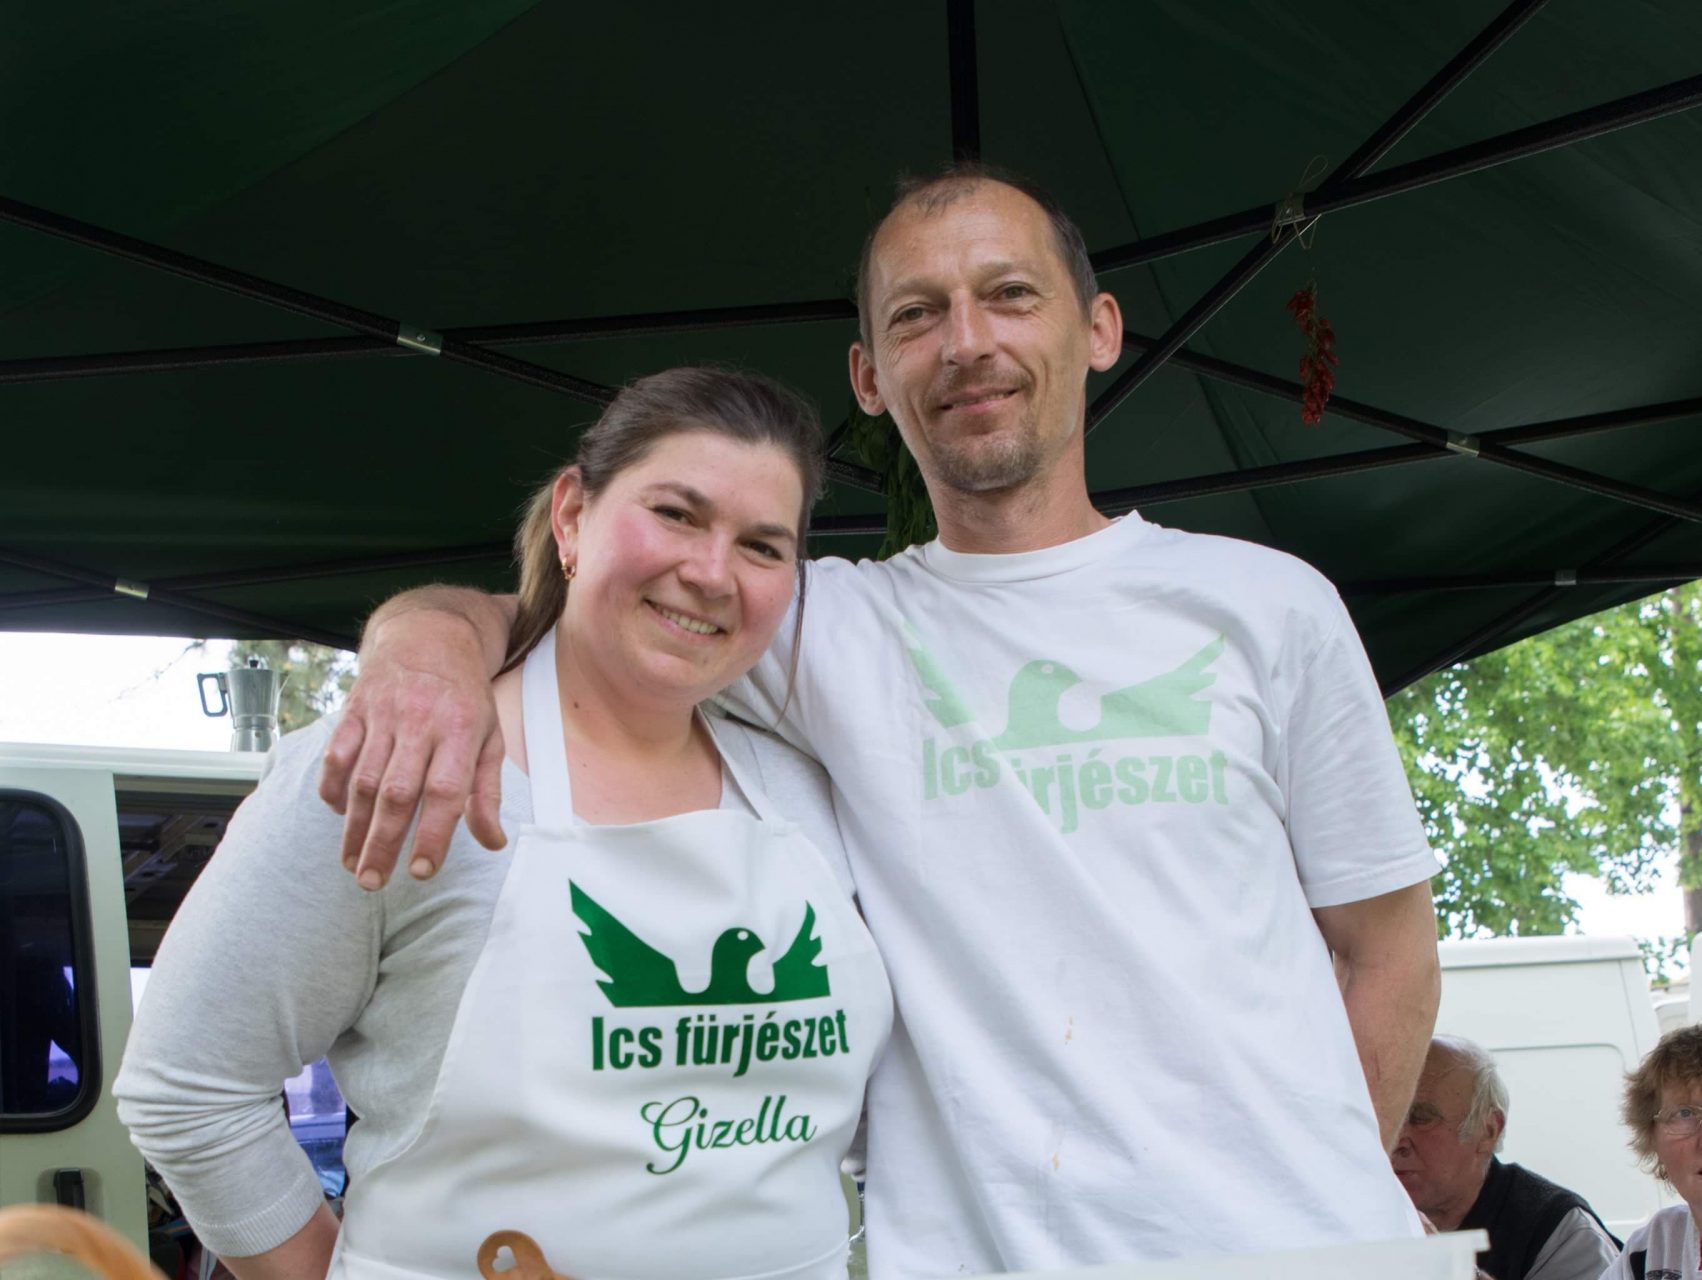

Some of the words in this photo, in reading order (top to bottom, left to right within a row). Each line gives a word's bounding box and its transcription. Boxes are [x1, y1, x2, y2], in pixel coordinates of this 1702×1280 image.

[922, 737, 999, 801] Ics
[1010, 748, 1229, 835] rjészet
[592, 1016, 663, 1071] Ics
[676, 1009, 850, 1078] fürjészet
[640, 1095, 818, 1175] Gizella
